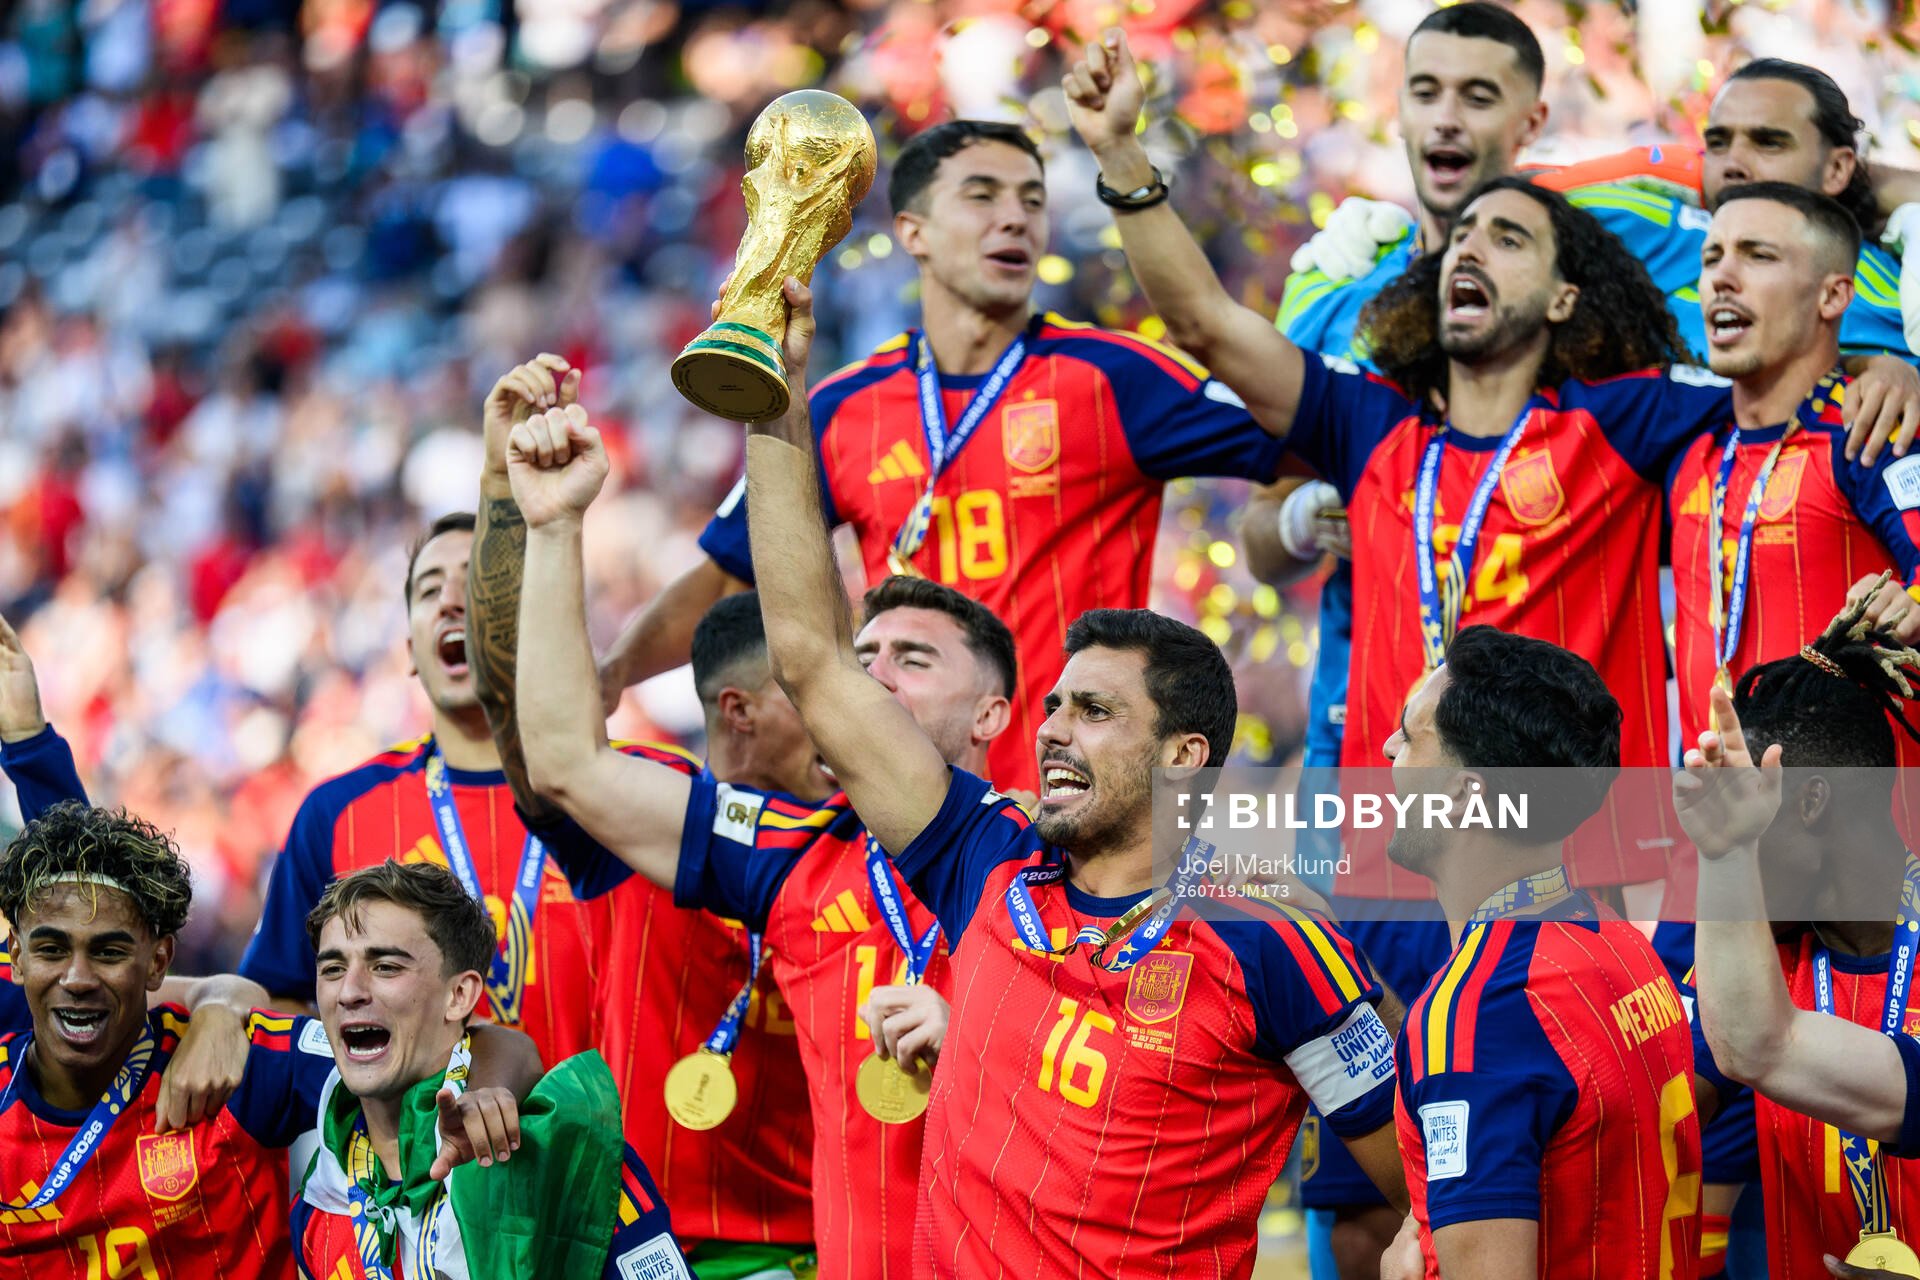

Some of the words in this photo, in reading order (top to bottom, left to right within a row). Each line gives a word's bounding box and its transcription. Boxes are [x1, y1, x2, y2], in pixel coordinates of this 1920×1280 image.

[931, 489, 1009, 584] 18
[1009, 887, 1026, 912] CUP
[1818, 956, 1829, 1007] 2026
[1892, 945, 1910, 998] 2026
[1331, 1008, 1377, 1049] FOOTBALL
[1609, 975, 1682, 1051] MERINO
[1887, 998, 1900, 1028] CUP
[1038, 997, 1117, 1108] 16
[1337, 1019, 1387, 1062] UNITES
[1344, 1060, 1370, 1078] the
[52, 1162, 72, 1188] CUP
[69, 1120, 104, 1165] 2026
[631, 1248, 668, 1272] FOOTBALL
